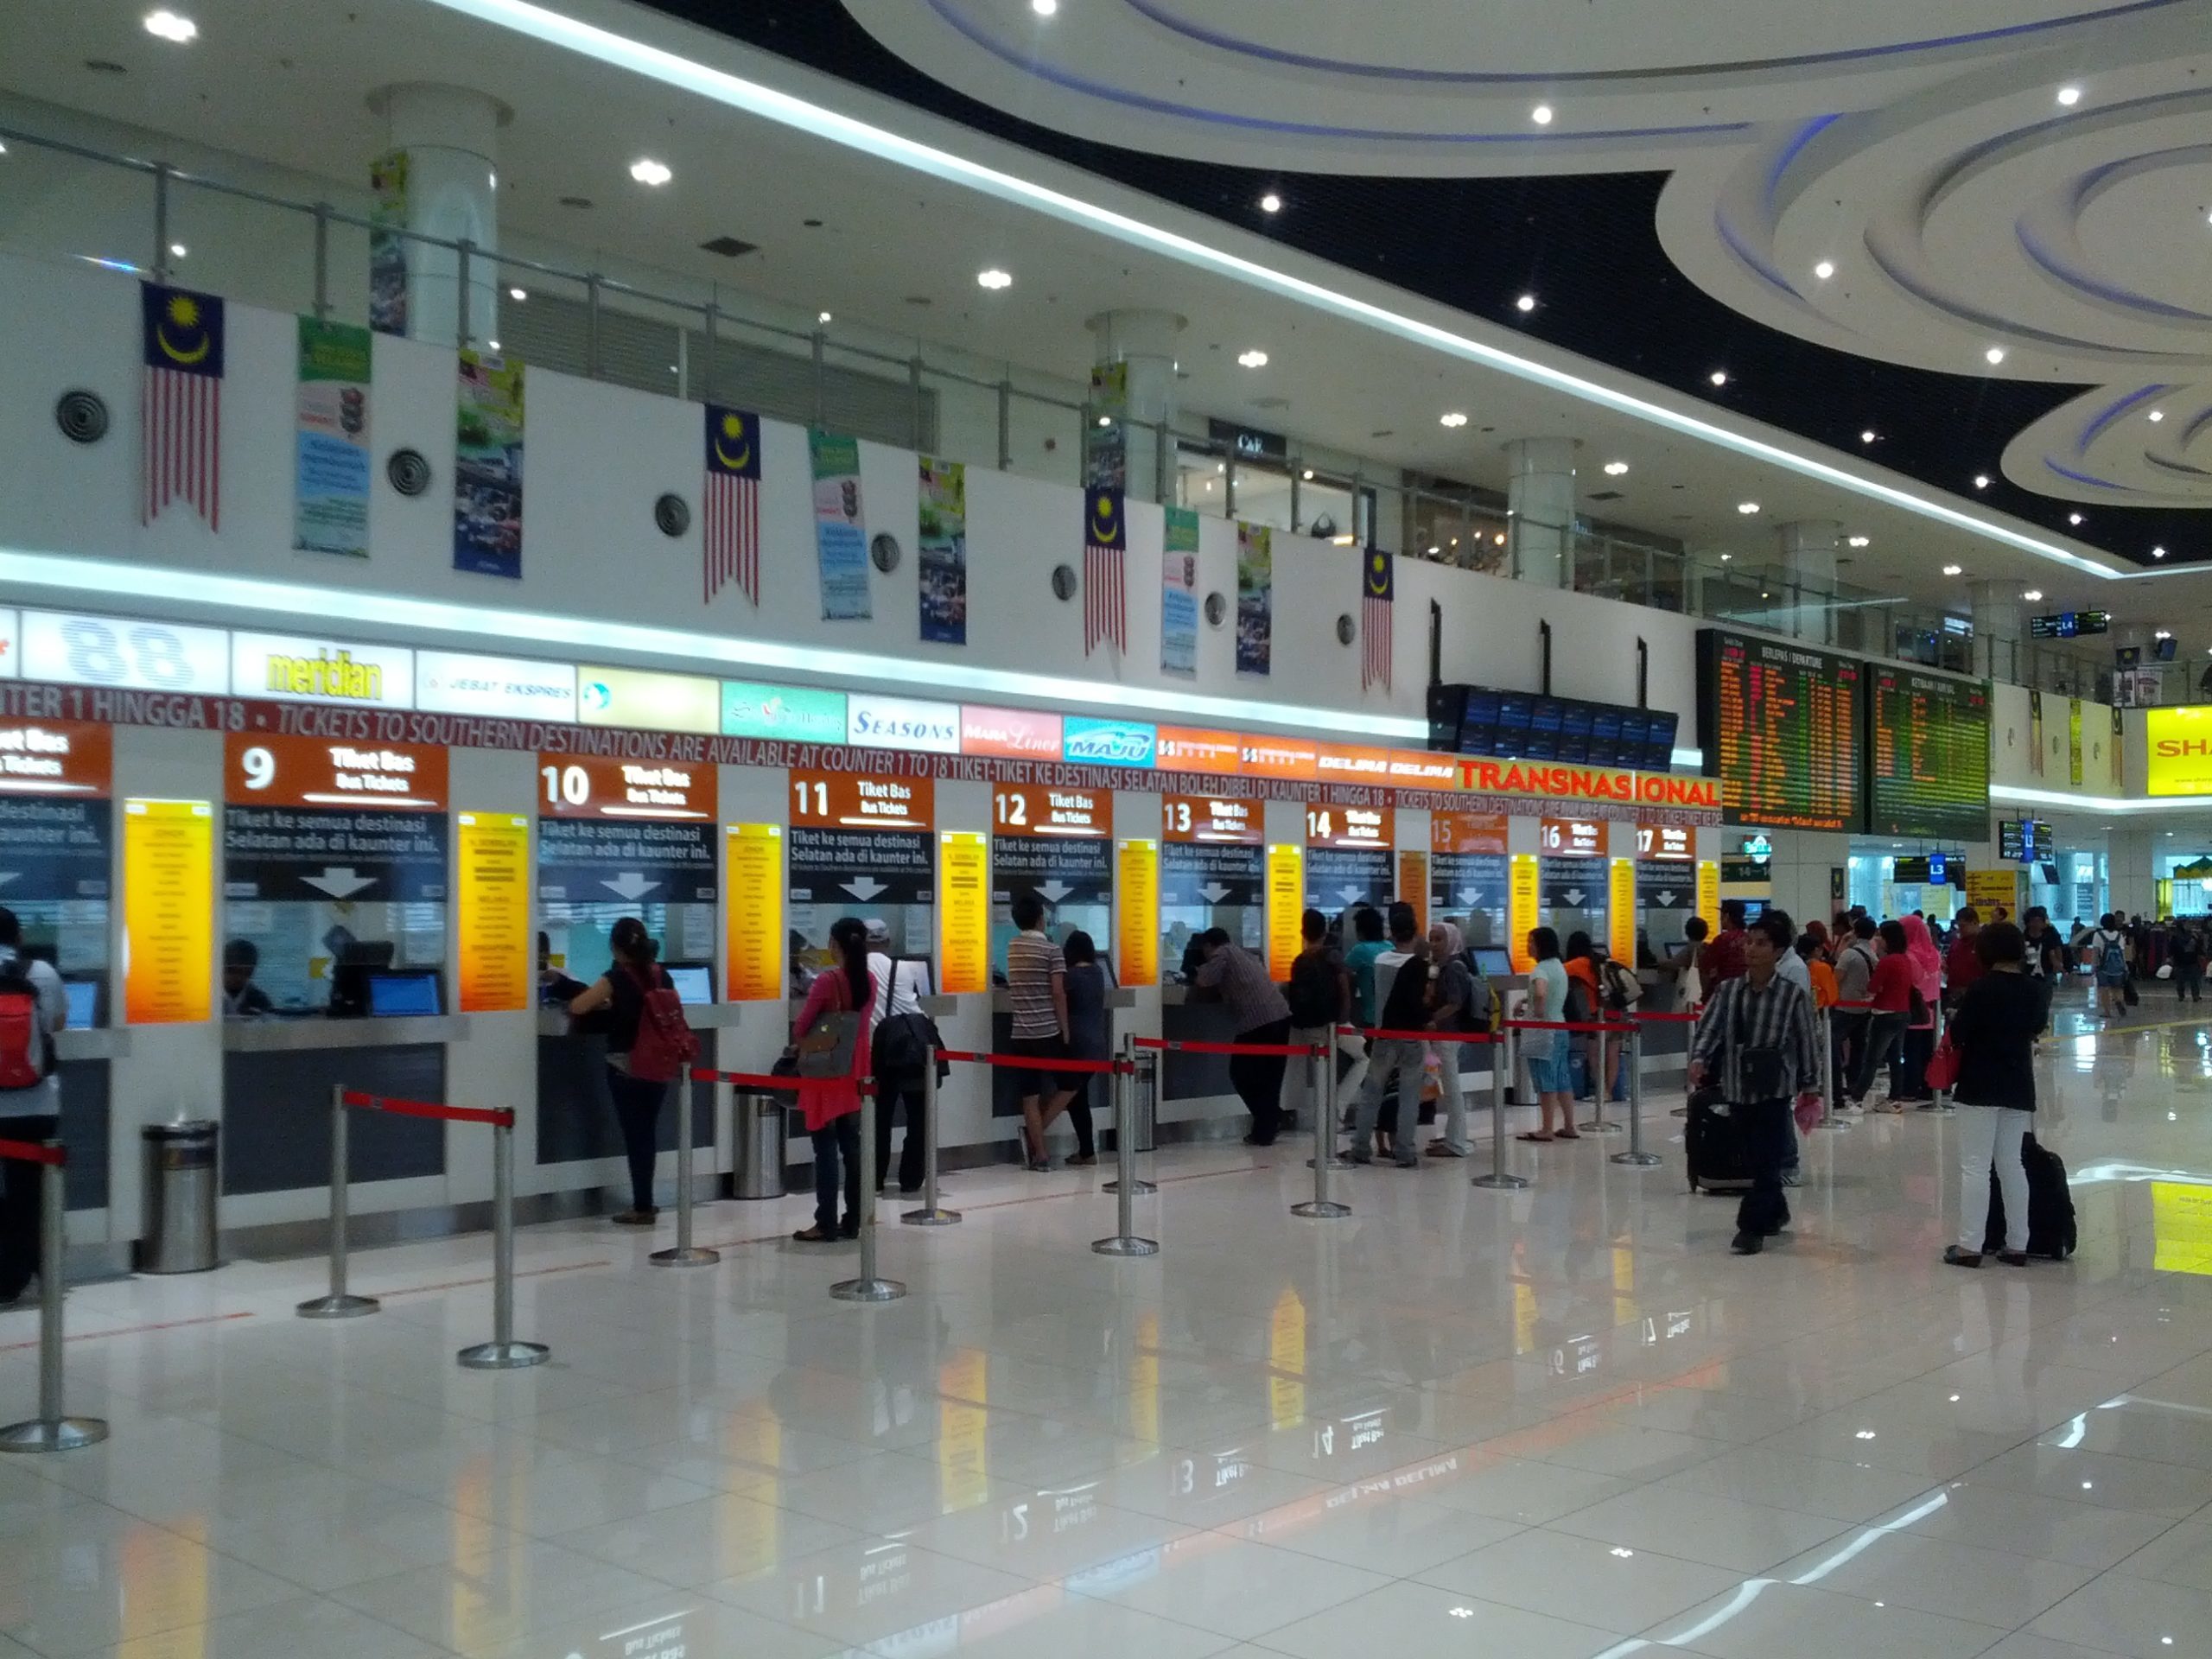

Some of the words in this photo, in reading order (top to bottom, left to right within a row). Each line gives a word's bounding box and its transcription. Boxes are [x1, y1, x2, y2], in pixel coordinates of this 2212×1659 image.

[60, 620, 195, 688] 88
[266, 647, 383, 701] meridian
[449, 678, 499, 692] JEBAT
[505, 683, 572, 699] EKSPRES
[853, 709, 955, 741] SEASONS
[71, 688, 84, 720] 1
[92, 690, 207, 728] HINGGA
[213, 701, 246, 731] 18
[278, 703, 369, 739] TICKETS
[373, 710, 406, 741] TO
[408, 715, 526, 751] SOUTHERN
[528, 723, 668, 760] DESTINATIONS
[670, 735, 705, 762] ARE
[707, 738, 796, 767] AVAILABLE
[798, 745, 820, 769] AT
[822, 746, 894, 774] COUNTER
[898, 753, 904, 776] 1
[909, 753, 928, 777] TO
[932, 756, 948, 779] 18
[952, 757, 1033, 783] TIKET-TIKET
[1036, 764, 1052, 785] KE
[1055, 765, 1122, 790] DESTINASI
[1124, 769, 1178, 792] SELATAN
[1180, 772, 1218, 795] BOLEH
[1220, 777, 1255, 798] DIBELI
[1258, 780, 1270, 798] DI
[1272, 781, 1322, 803] KAUNTER
[1331, 785, 1370, 806] HINGGA
[1373, 789, 1384, 806] 18
[1395, 789, 1430, 810] TICKETS
[1071, 740, 1150, 760] MAJU
[2157, 739, 2212, 758] SH
[242, 747, 276, 791] 9
[1319, 756, 1388, 773] DELIMA
[1389, 762, 1453, 778] DELIMA
[541, 766, 590, 805] 10
[857, 781, 888, 798] Tiket
[889, 783, 912, 799] Bas
[1457, 760, 1720, 809] TRANSNASIONAL
[795, 781, 828, 816] 11
[878, 802, 908, 816] Tickets
[1048, 793, 1075, 809] Tiket
[1076, 795, 1094, 810] Bas
[995, 793, 1027, 826] 12
[1164, 803, 1192, 833] 13
[354, 814, 427, 834] destinasi
[540, 821, 576, 838] Tiket
[577, 822, 595, 839] ke
[596, 826, 641, 841] semua
[643, 824, 701, 842] destinasi
[1307, 810, 1332, 839] 14
[1432, 819, 1452, 843] 15
[348, 834, 410, 853] kaunter
[791, 830, 819, 845] Tiket
[821, 831, 834, 846] ke
[836, 835, 872, 848] semua
[873, 834, 920, 849] destinasi
[994, 838, 1018, 853] Tiket
[1019, 840, 1030, 853] ke
[1031, 843, 1061, 854] semua
[1062, 842, 1101, 855] destinasi
[1541, 825, 1560, 849] 16
[1636, 830, 1654, 852] 17
[638, 842, 689, 859] kaunter
[791, 847, 833, 862] Selatan
[835, 848, 855, 862] ada
[856, 849, 868, 863] di
[870, 850, 911, 865] kaunter
[912, 851, 929, 865] ini.
[994, 854, 1028, 868] Selatan
[1029, 855, 1046, 868] ada
[1047, 855, 1058, 868] di
[1058, 855, 1092, 868] kaunter
[1930, 864, 1944, 874] L3
